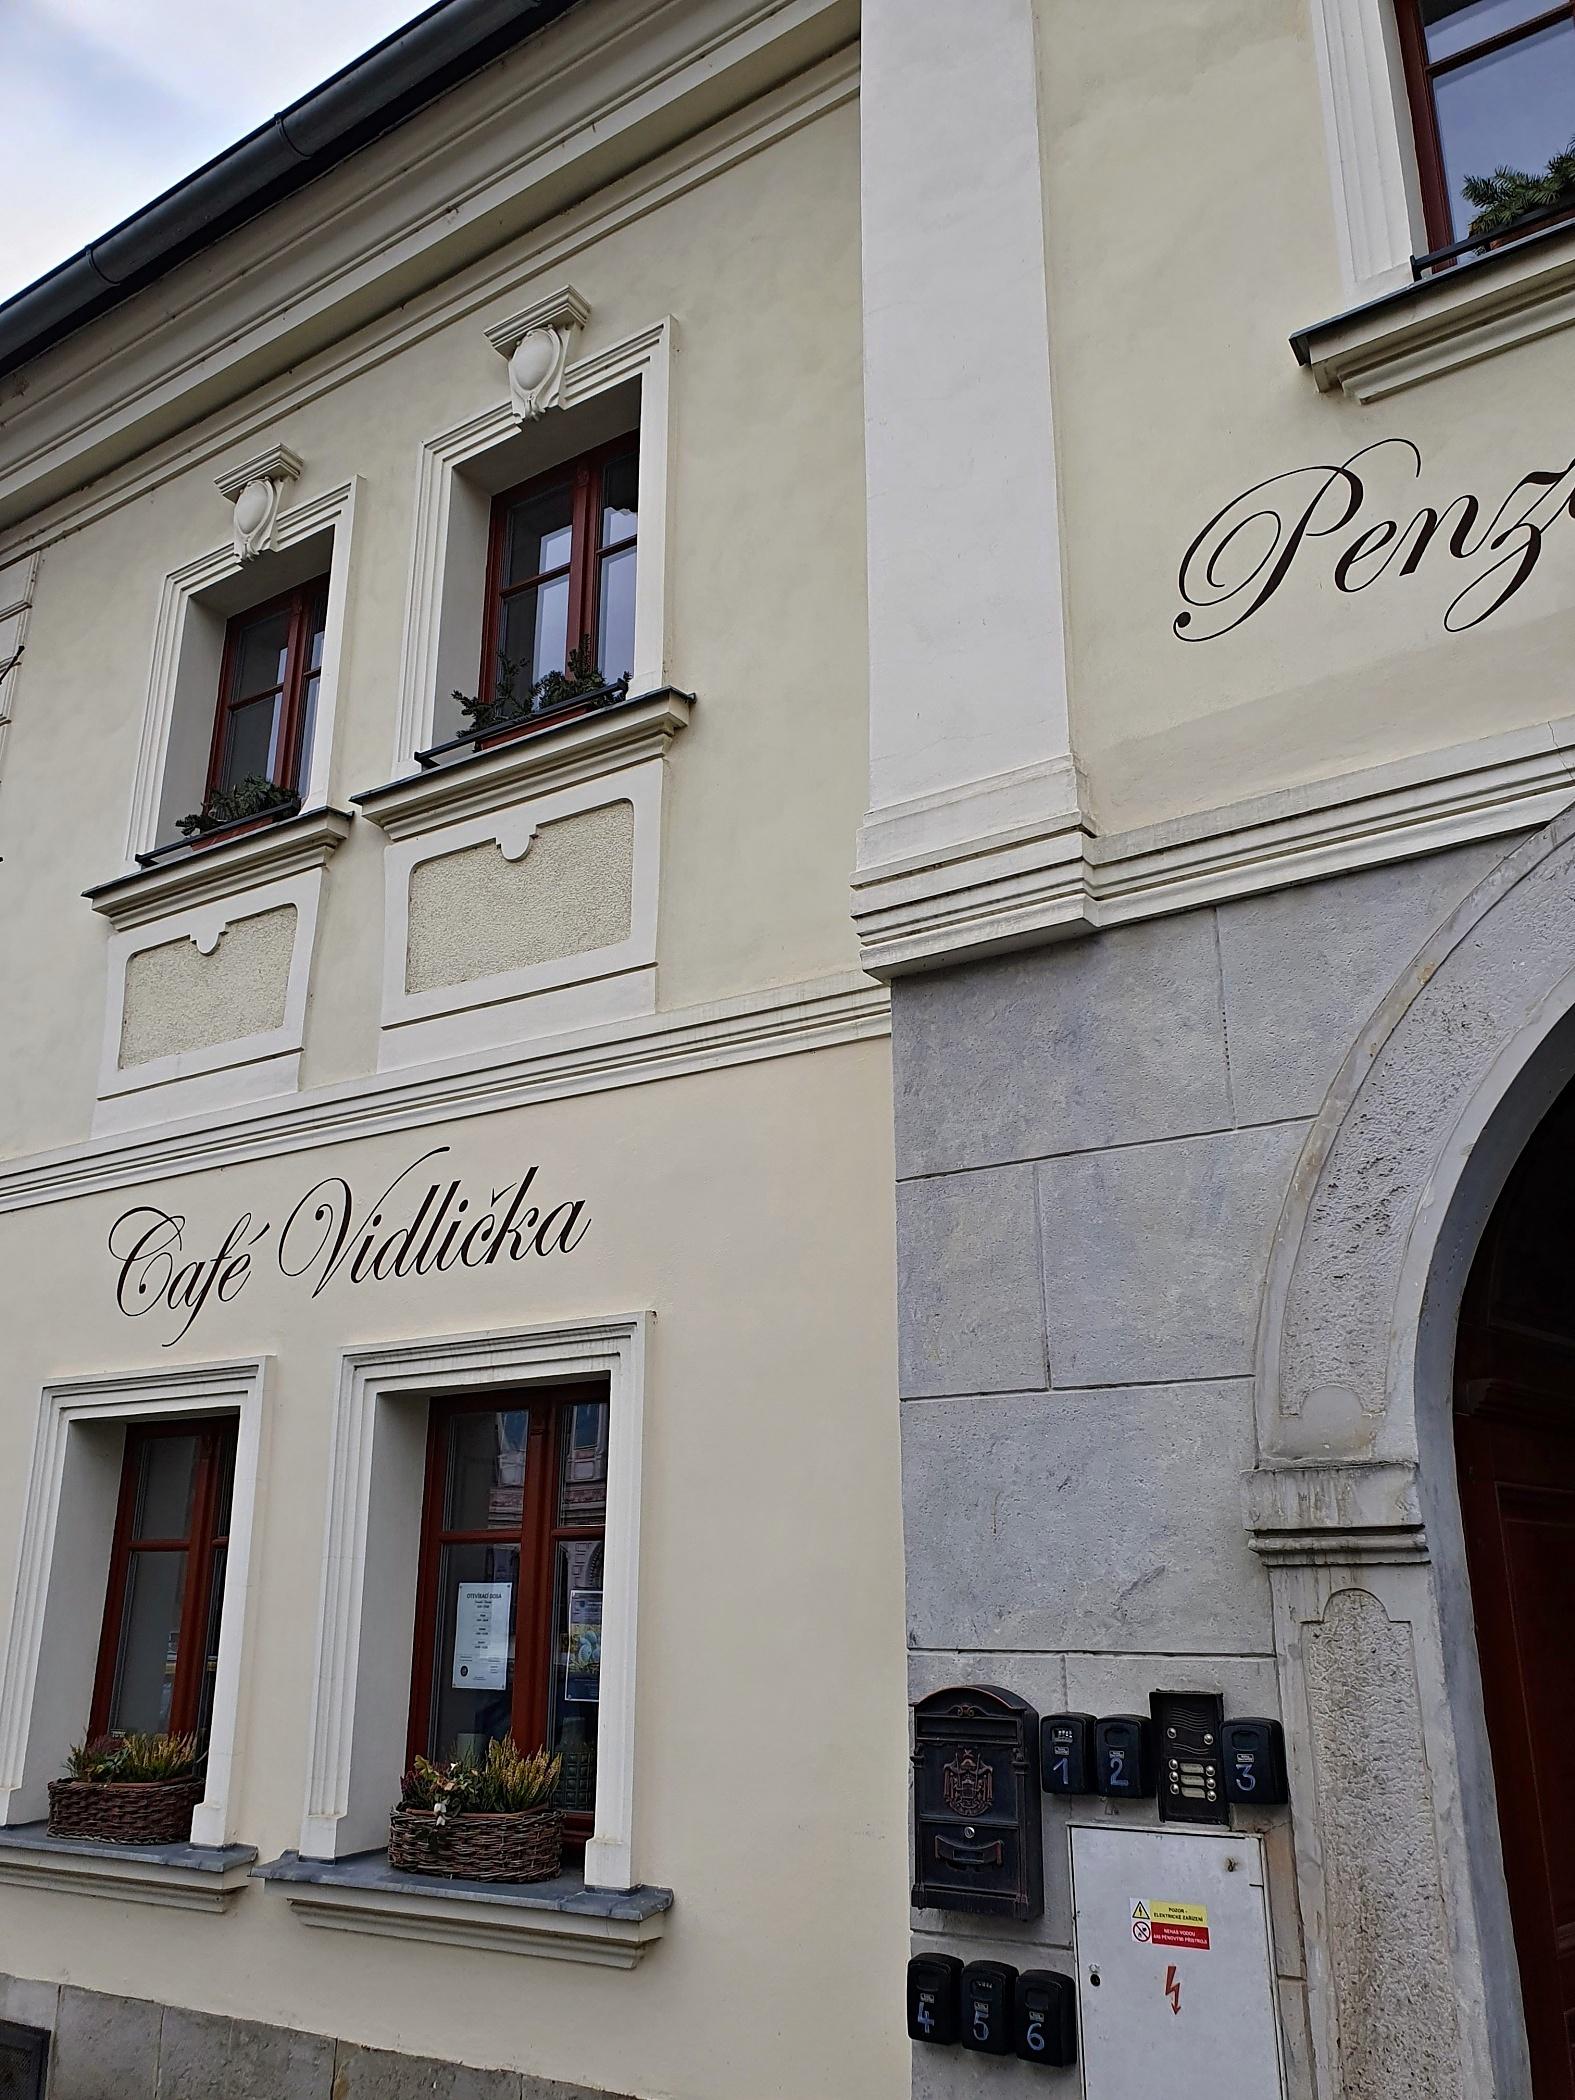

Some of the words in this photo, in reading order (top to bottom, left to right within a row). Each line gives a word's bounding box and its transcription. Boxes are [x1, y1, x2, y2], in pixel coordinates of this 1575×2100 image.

[1173, 438, 1575, 642] Penz
[108, 1206, 270, 1347] Café
[278, 1146, 592, 1299] Vidlička
[1053, 1757, 1069, 1785] 1
[1110, 1757, 1129, 1786] 2
[1235, 1764, 1256, 1791] 3
[918, 2001, 935, 2033] 4
[973, 2010, 989, 2041] 5
[1026, 2022, 1045, 2051] 6
